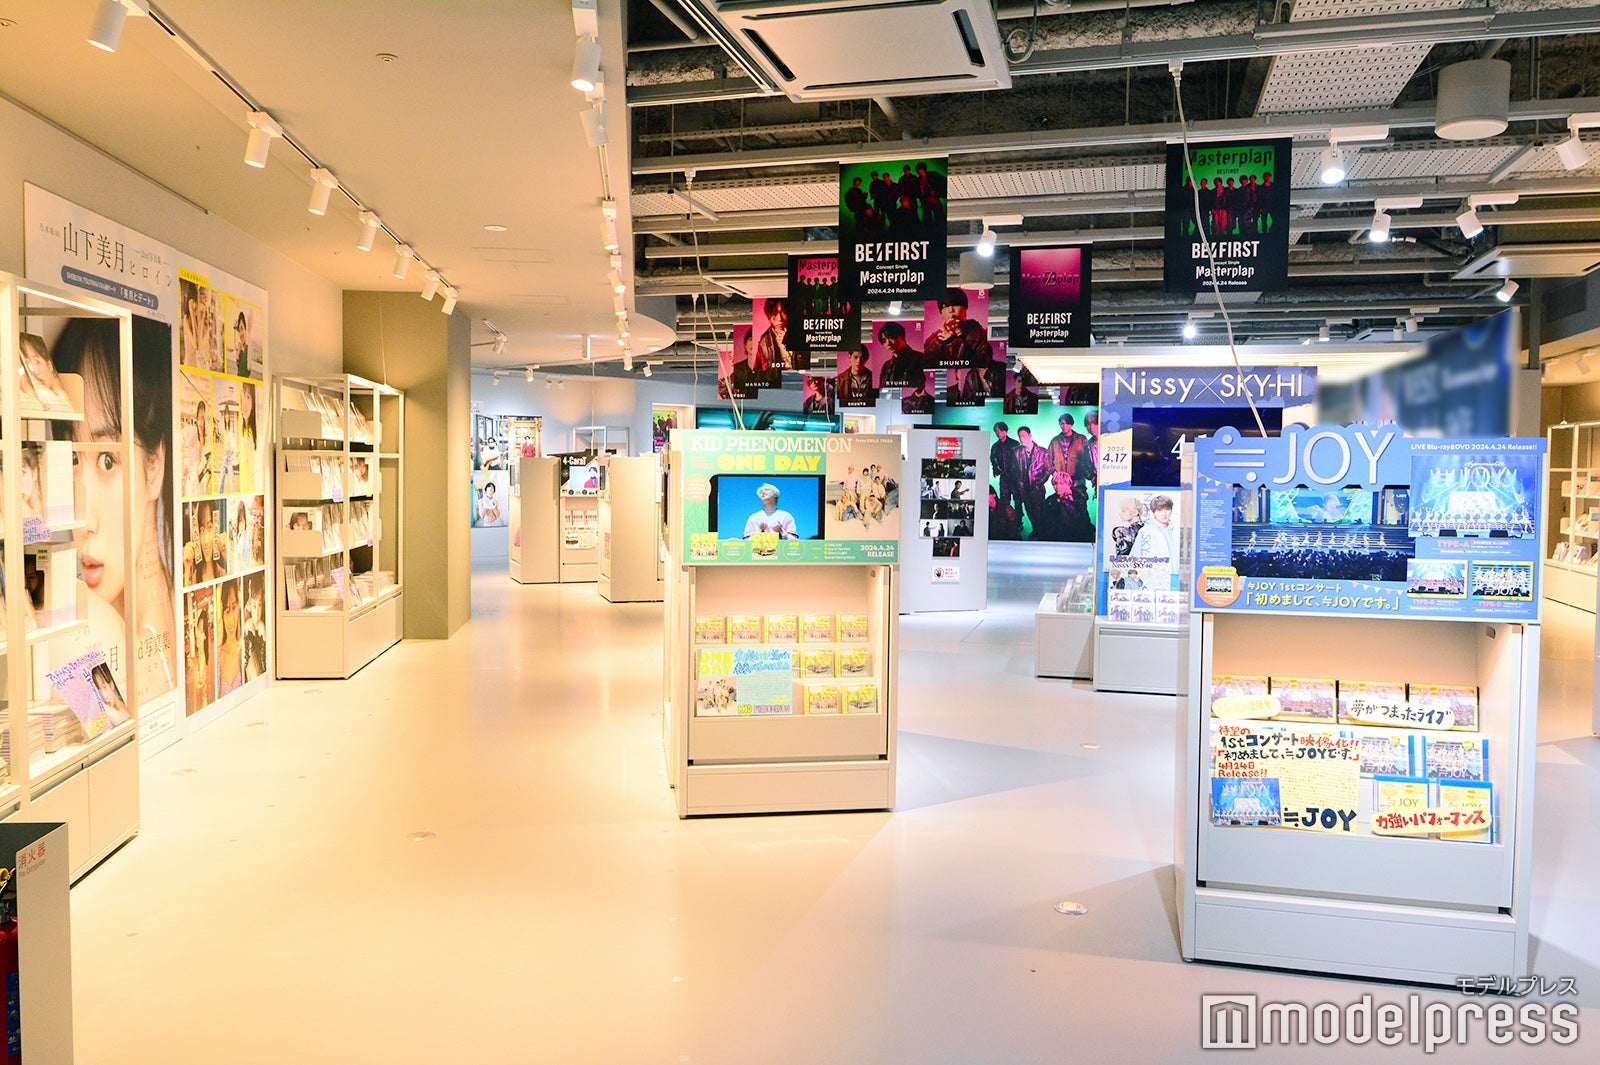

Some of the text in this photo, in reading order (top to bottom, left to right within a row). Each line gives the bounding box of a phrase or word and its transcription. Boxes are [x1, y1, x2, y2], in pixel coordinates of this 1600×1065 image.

[63, 222, 124, 273] 山下美月
[799, 260, 837, 272] Masterp
[860, 269, 925, 287] Masterplan
[805, 334, 842, 343] Masterplan
[1029, 329, 1069, 338] Masterplan
[690, 435, 853, 453] KID PHENOMENON
[716, 454, 822, 472] ONE DAY
[1103, 453, 1127, 463] 4.17
[1279, 582, 1342, 593] 1stコンサート
[1350, 699, 1452, 725] 夢がつまったライブ
[1218, 725, 1250, 736] 待望の
[1218, 761, 1255, 770] 4月24日
[1218, 769, 1268, 778] Release!!
[1375, 809, 1487, 830] 力強いパフォーマンス
[18, 841, 46, 870] 消火器
